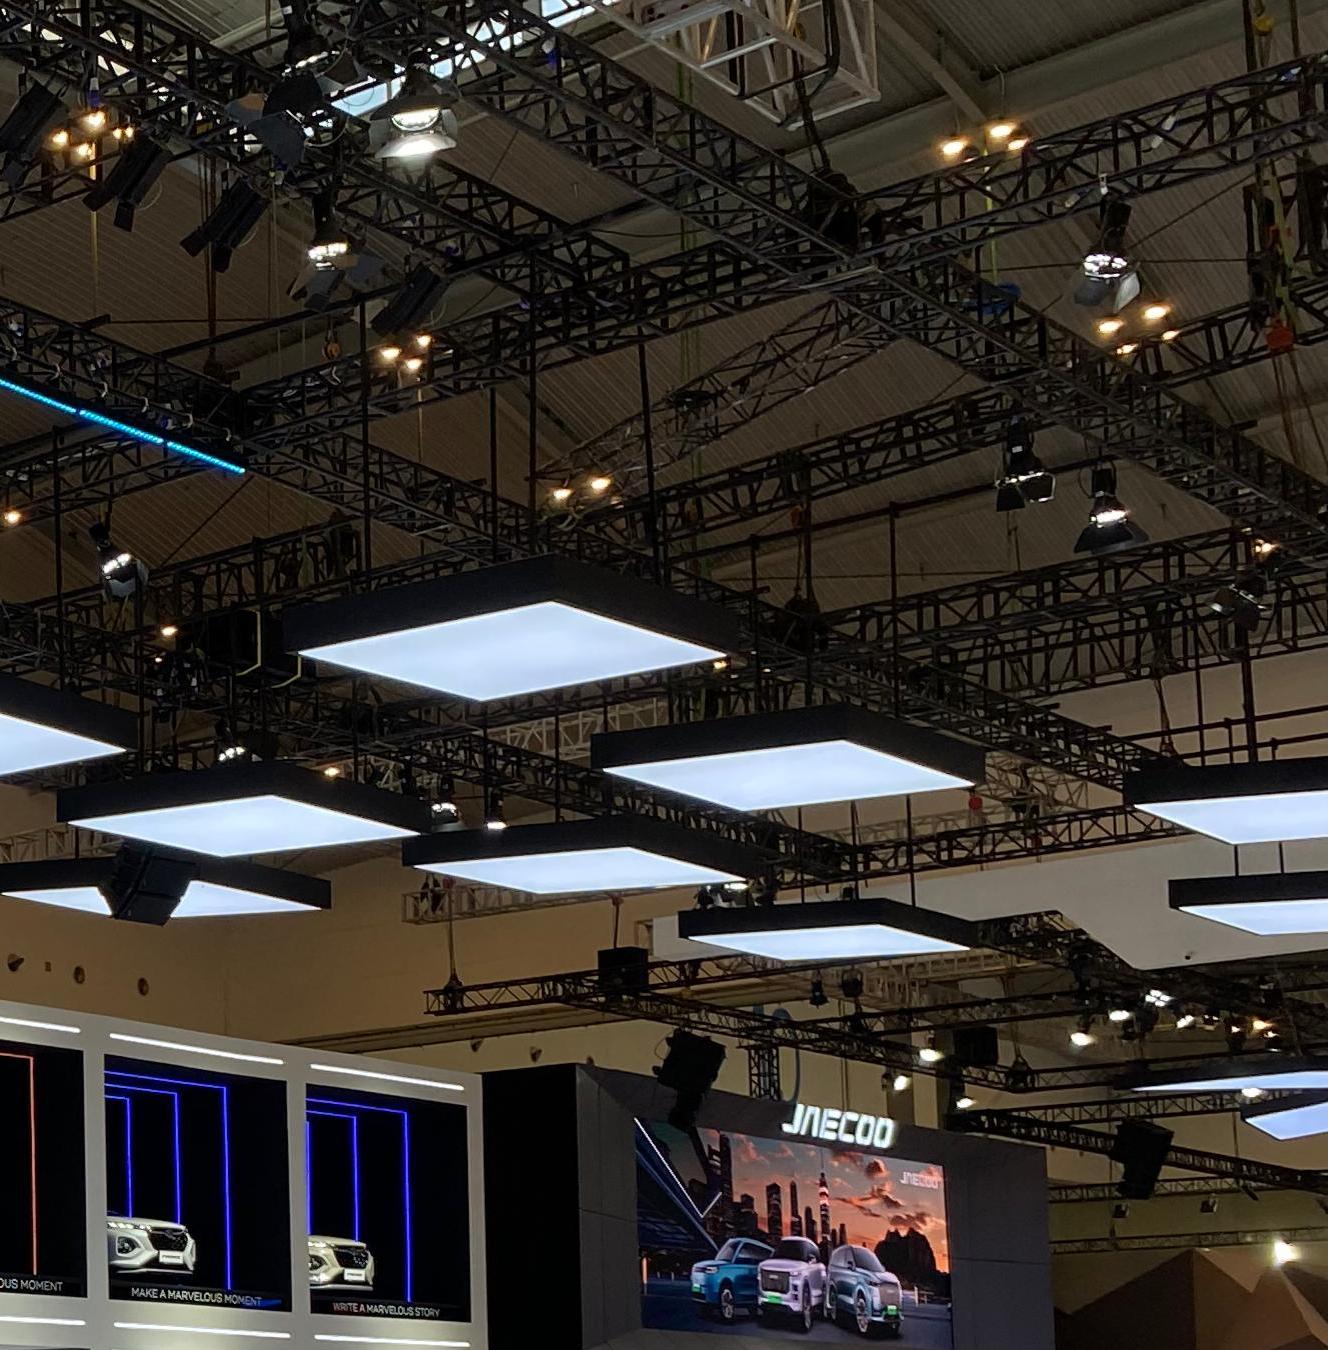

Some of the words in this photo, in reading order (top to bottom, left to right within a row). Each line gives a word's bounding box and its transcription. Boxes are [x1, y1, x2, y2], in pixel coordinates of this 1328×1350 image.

[781, 1103, 896, 1149] JAECOO
[20, 1279, 64, 1292] MOMENT
[131, 1287, 158, 1299] MAKE
[159, 1289, 167, 1299] A
[168, 1290, 223, 1304] MARVELOUS
[224, 1294, 262, 1307] MOMENT
[332, 1302, 358, 1313] WRITE
[359, 1303, 366, 1313] A
[366, 1303, 414, 1316] MARVELOUS
[415, 1307, 440, 1317] STORY
